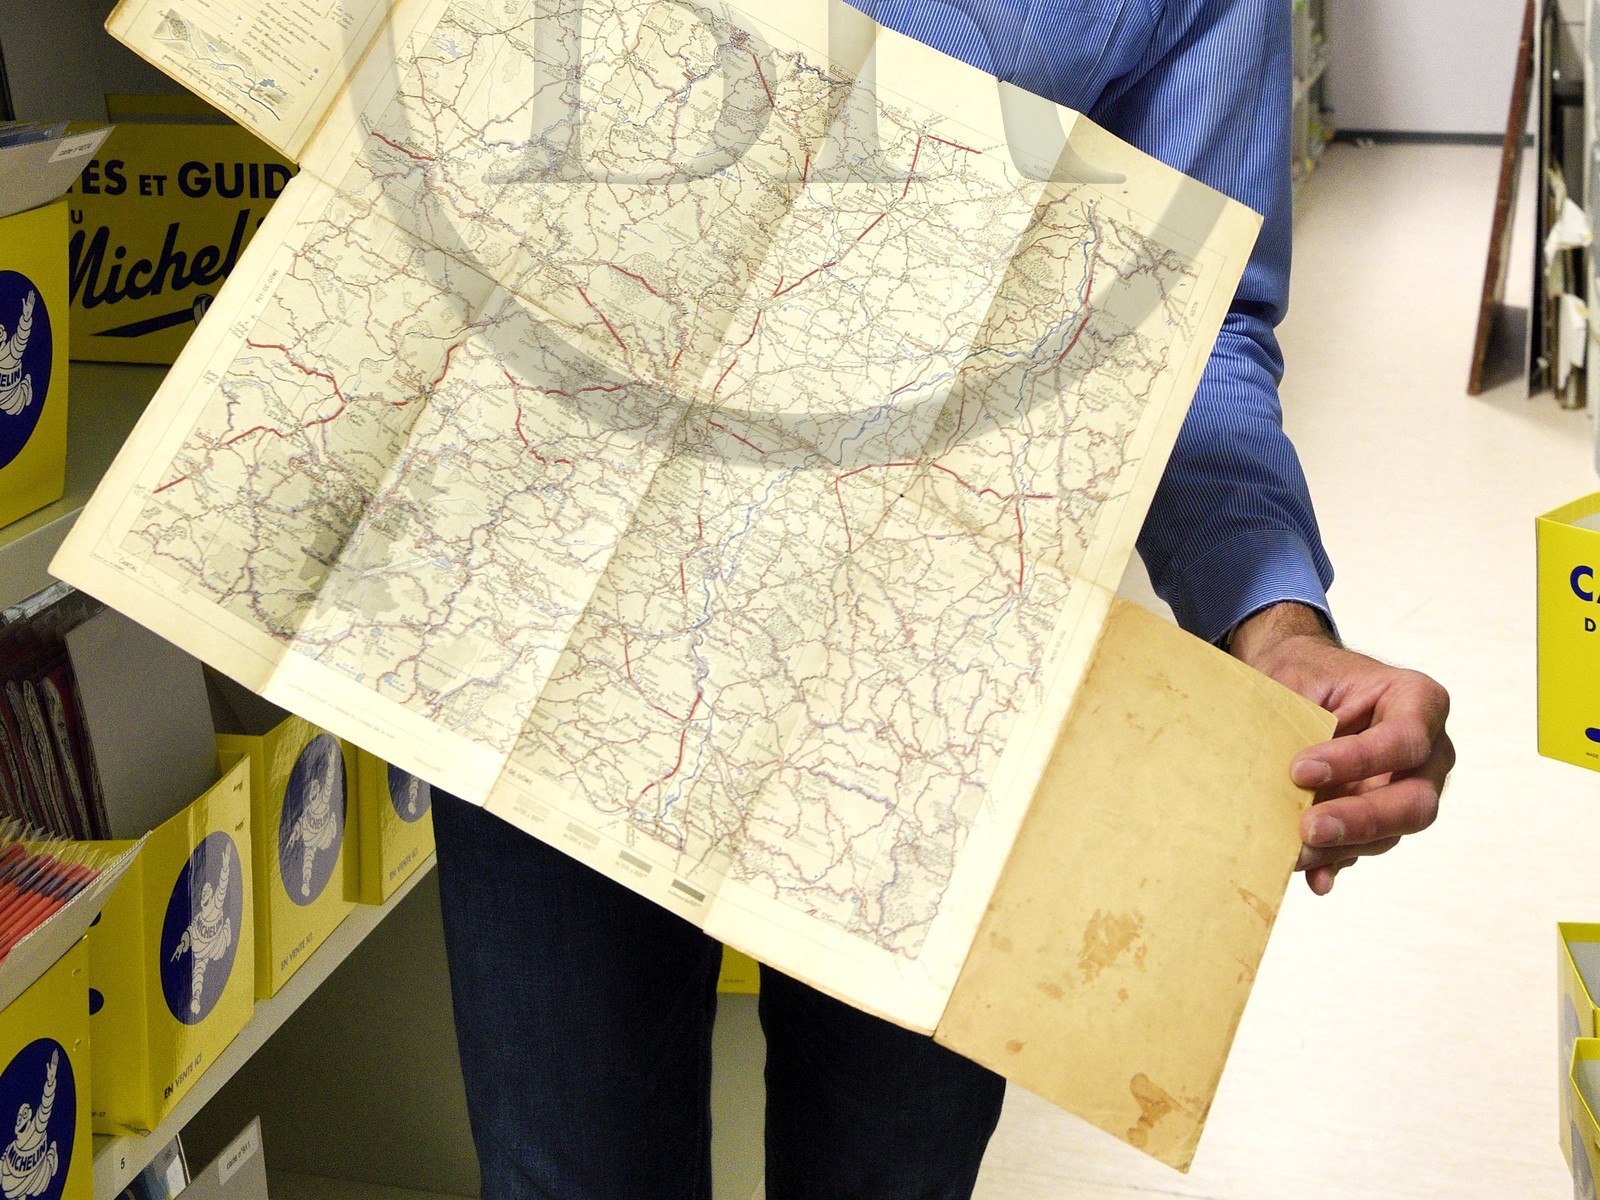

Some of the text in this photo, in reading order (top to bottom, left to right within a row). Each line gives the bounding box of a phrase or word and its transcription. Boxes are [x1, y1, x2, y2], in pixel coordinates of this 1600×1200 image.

[66, 159, 299, 200] ES ET GUID
[68, 209, 267, 309] Michel
[0, 368, 21, 388] ELIN
[163, 1052, 203, 1101] EN VENTE ICI
[8, 1140, 46, 1173] MICHELIN
[120, 1156, 125, 1170] 5
